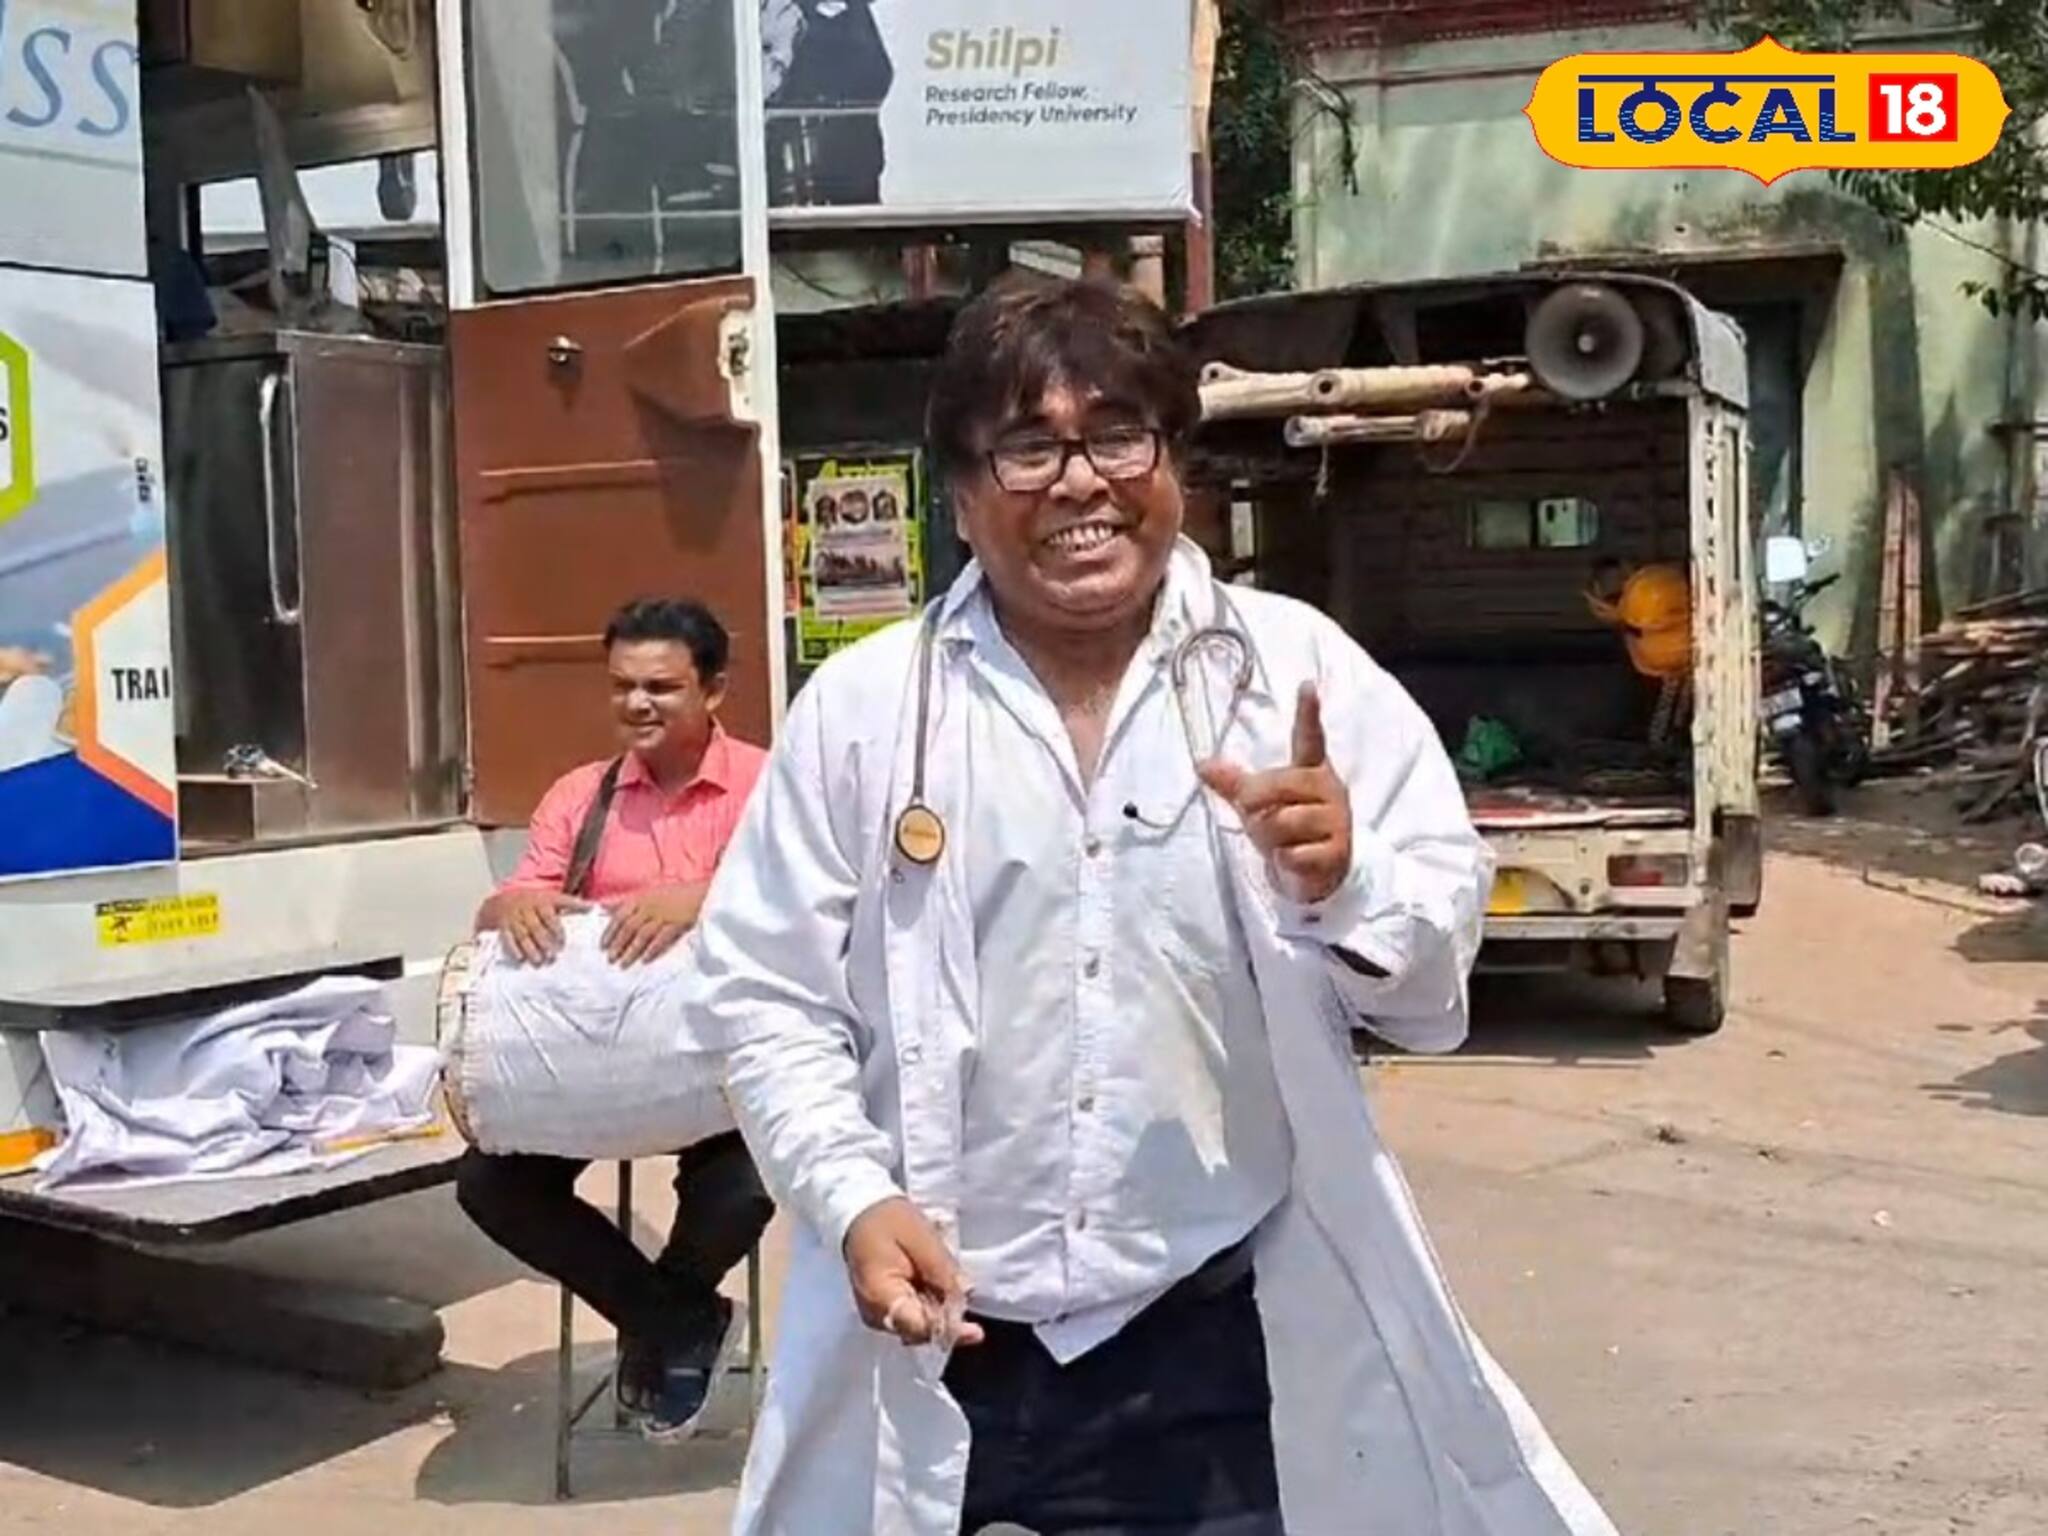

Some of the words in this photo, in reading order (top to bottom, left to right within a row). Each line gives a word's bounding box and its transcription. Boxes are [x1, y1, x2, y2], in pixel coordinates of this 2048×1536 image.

[925, 27, 1060, 77] Shilpi
[926, 83, 1016, 102] Research
[926, 106, 1034, 127] Presidency
[1040, 102, 1138, 124] University
[111, 666, 170, 702] TRAI
